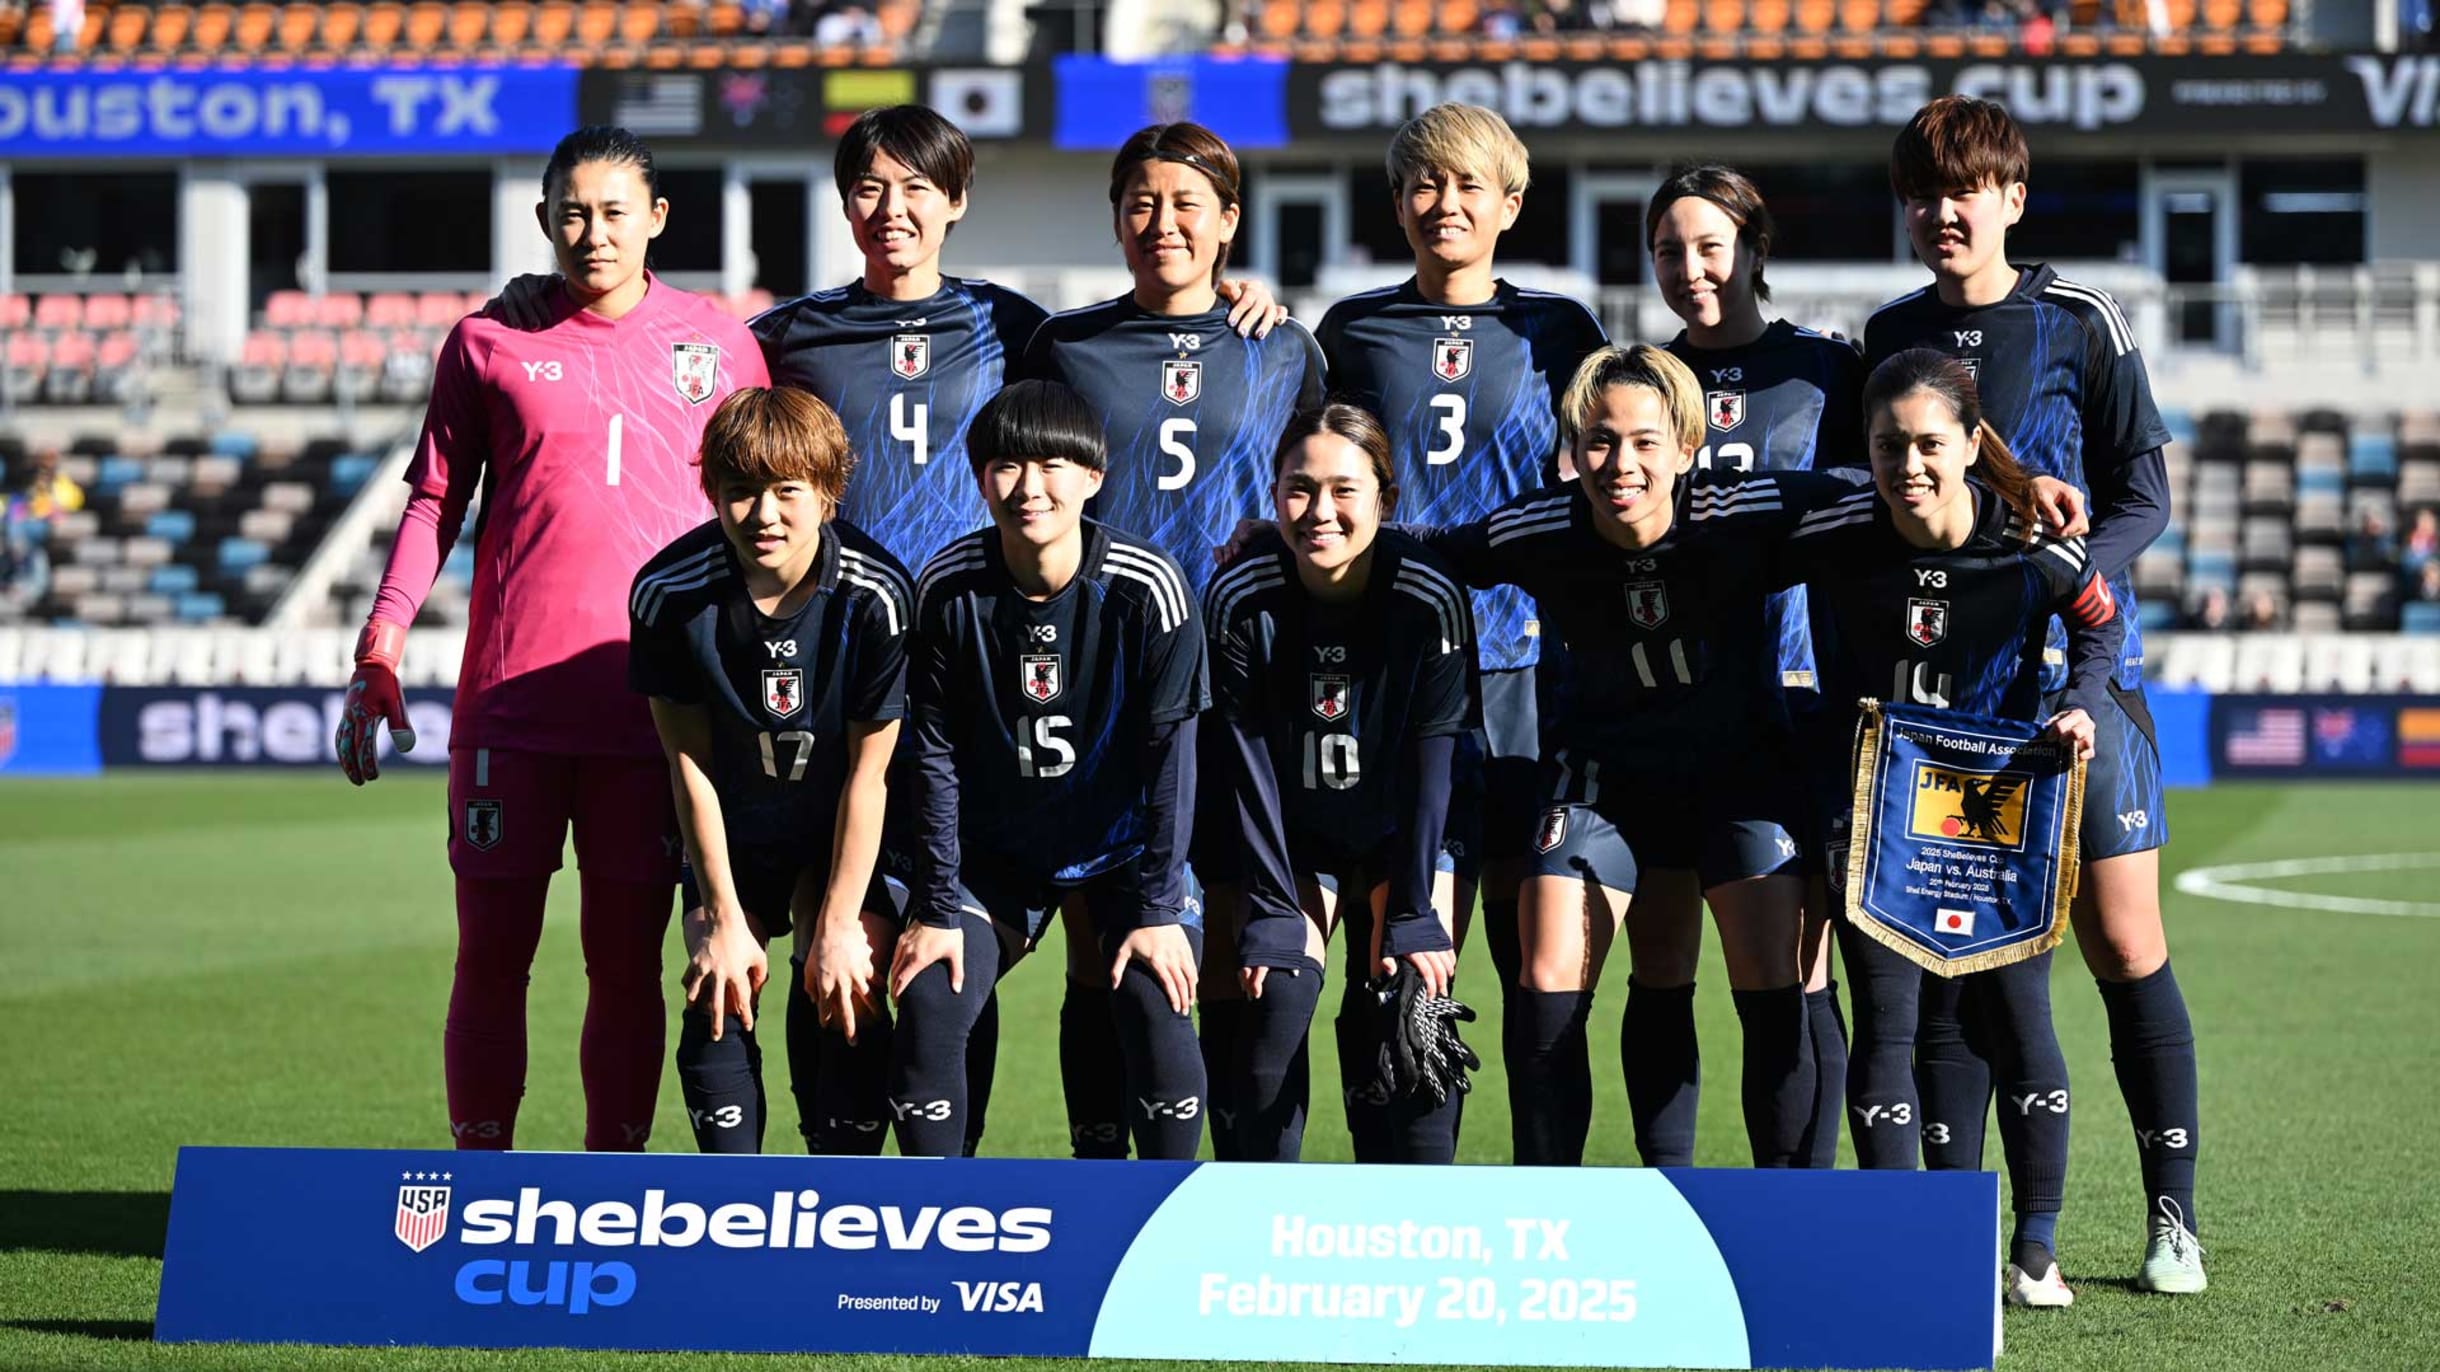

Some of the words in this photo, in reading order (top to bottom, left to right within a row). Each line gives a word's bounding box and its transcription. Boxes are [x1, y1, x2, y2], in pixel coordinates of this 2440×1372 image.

[371, 76, 500, 137] TX
[1953, 62, 2145, 131] cup
[1440, 315, 1472, 330] Y-3
[1168, 333, 1201, 349] Y-3
[1954, 330, 1983, 347] Y-3
[521, 361, 564, 382] Y-3
[1710, 367, 1743, 383] Y-3
[890, 393, 928, 464] 4
[1427, 394, 1466, 465] 3
[606, 413, 623, 486] 1
[1158, 418, 1198, 490] 5
[1626, 558, 1658, 574] Y-3
[1914, 568, 1948, 588] Y-3
[1025, 624, 1057, 642] Y-3
[764, 640, 798, 658] Y-3
[1313, 646, 1347, 663] Y-3
[1631, 638, 1692, 687] 11
[1017, 715, 1076, 778] 15
[1895, 727, 1933, 744] Japan
[1936, 735, 1986, 754] Football
[1987, 743, 2056, 757] Association
[758, 731, 815, 781] 17
[1303, 730, 1360, 790] 10
[1920, 771, 1961, 793] JFA
[2118, 809, 2149, 832] Y-3
[1921, 847, 1941, 857] 2025
[1942, 850, 1987, 862] SheBelieves
[1905, 857, 1942, 874] Japan
[1946, 865, 1962, 876] vs.
[1966, 865, 2018, 882] Australia
[889, 1096, 952, 1121] Y-3
[1138, 1096, 1199, 1120] Y-3
[1853, 1103, 1912, 1127] Y-3
[2011, 1089, 2069, 1116] Y-3
[688, 1105, 742, 1129] Y-3
[2137, 1128, 2188, 1149] Y-3
[402, 1189, 448, 1215] USA
[460, 1187, 1052, 1253] shebelieves
[1272, 1214, 1493, 1266] Houston,
[1505, 1218, 1572, 1261] TX
[455, 1259, 637, 1314] cup
[838, 1294, 918, 1311] Presented
[921, 1295, 940, 1313] by
[951, 1281, 1044, 1312] VISA
[1199, 1272, 1426, 1328] February
[1436, 1277, 1506, 1326] 20,
[1519, 1279, 1638, 1322] 2025
